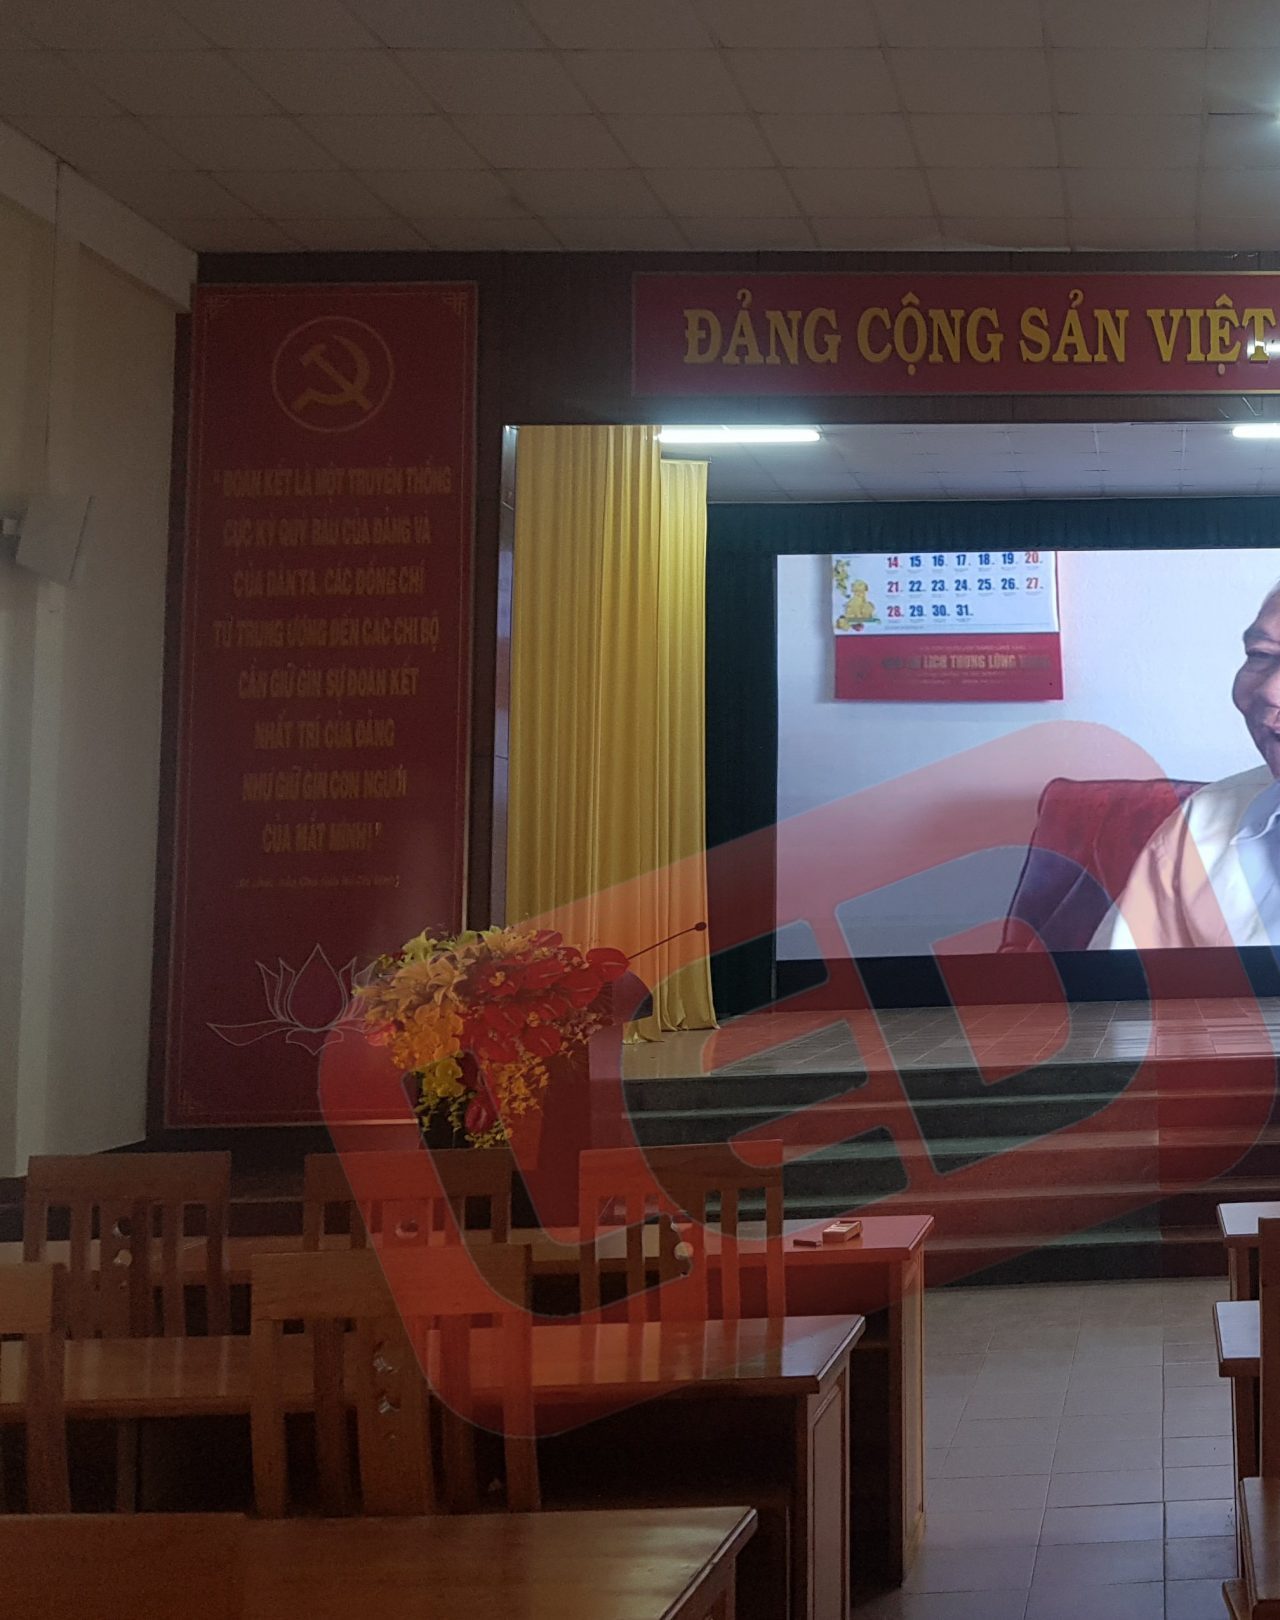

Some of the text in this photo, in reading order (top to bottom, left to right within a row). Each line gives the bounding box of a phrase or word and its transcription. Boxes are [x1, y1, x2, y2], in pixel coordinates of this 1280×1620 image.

[683, 289, 841, 365] ĐẢNG
[857, 291, 1003, 375] CỘNG
[1019, 289, 1130, 363] SẢN
[1146, 293, 1276, 375] VIỆT
[887, 552, 1039, 568] 14 15 16 17 18 19 20
[887, 577, 1039, 592] 21 22 23 24 25 26 27
[910, 605, 923, 617] 29
